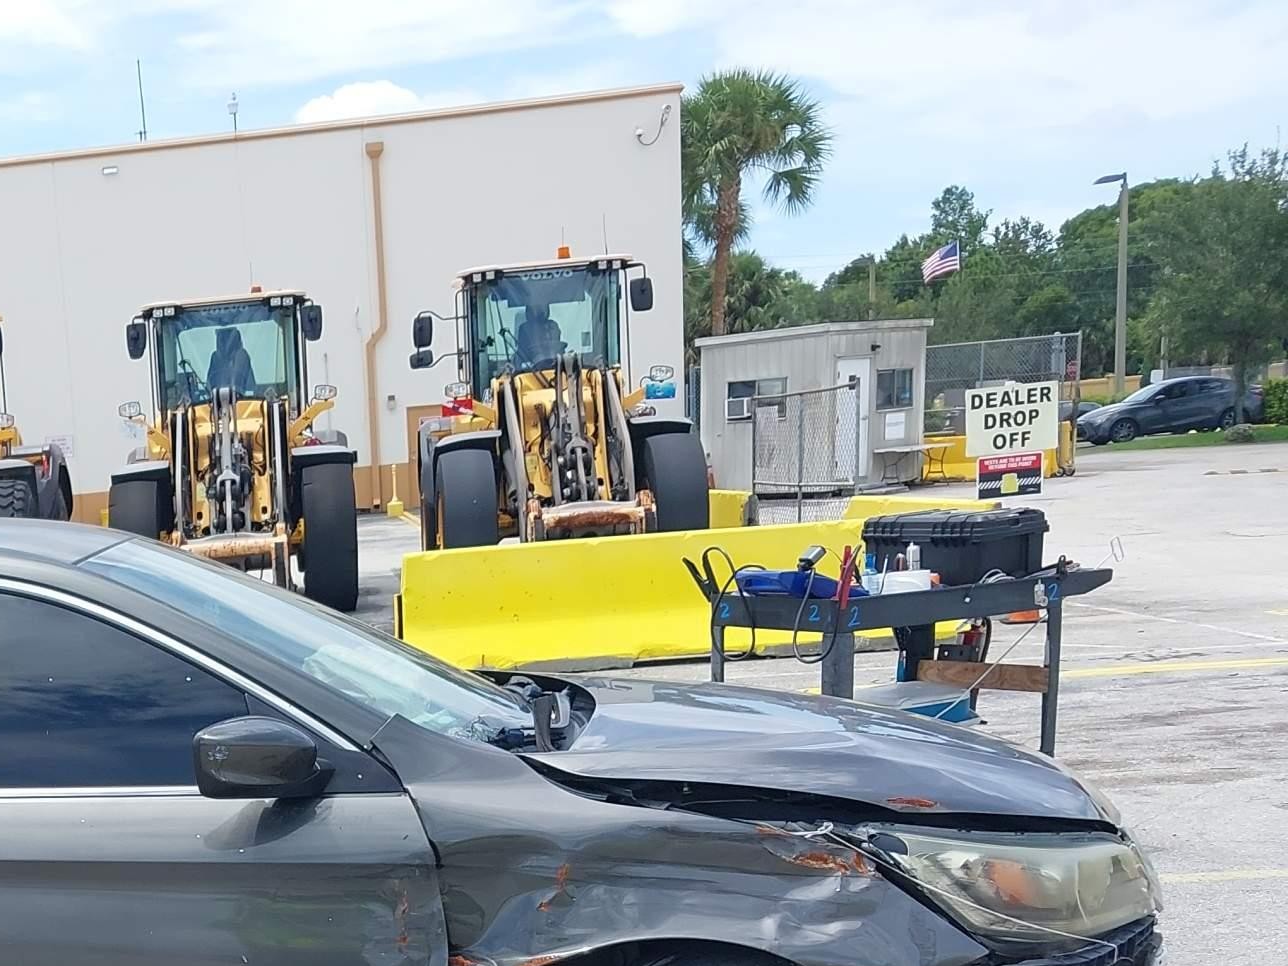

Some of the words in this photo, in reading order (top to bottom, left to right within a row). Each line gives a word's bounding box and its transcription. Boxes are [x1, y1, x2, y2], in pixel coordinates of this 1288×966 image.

[970, 386, 1052, 410] DEALER
[983, 409, 1040, 430] DROP
[992, 430, 1032, 450] OFF
[1048, 583, 1060, 600] 2
[719, 603, 730, 619] 2
[808, 604, 821, 622] 2
[847, 606, 861, 628] 2
